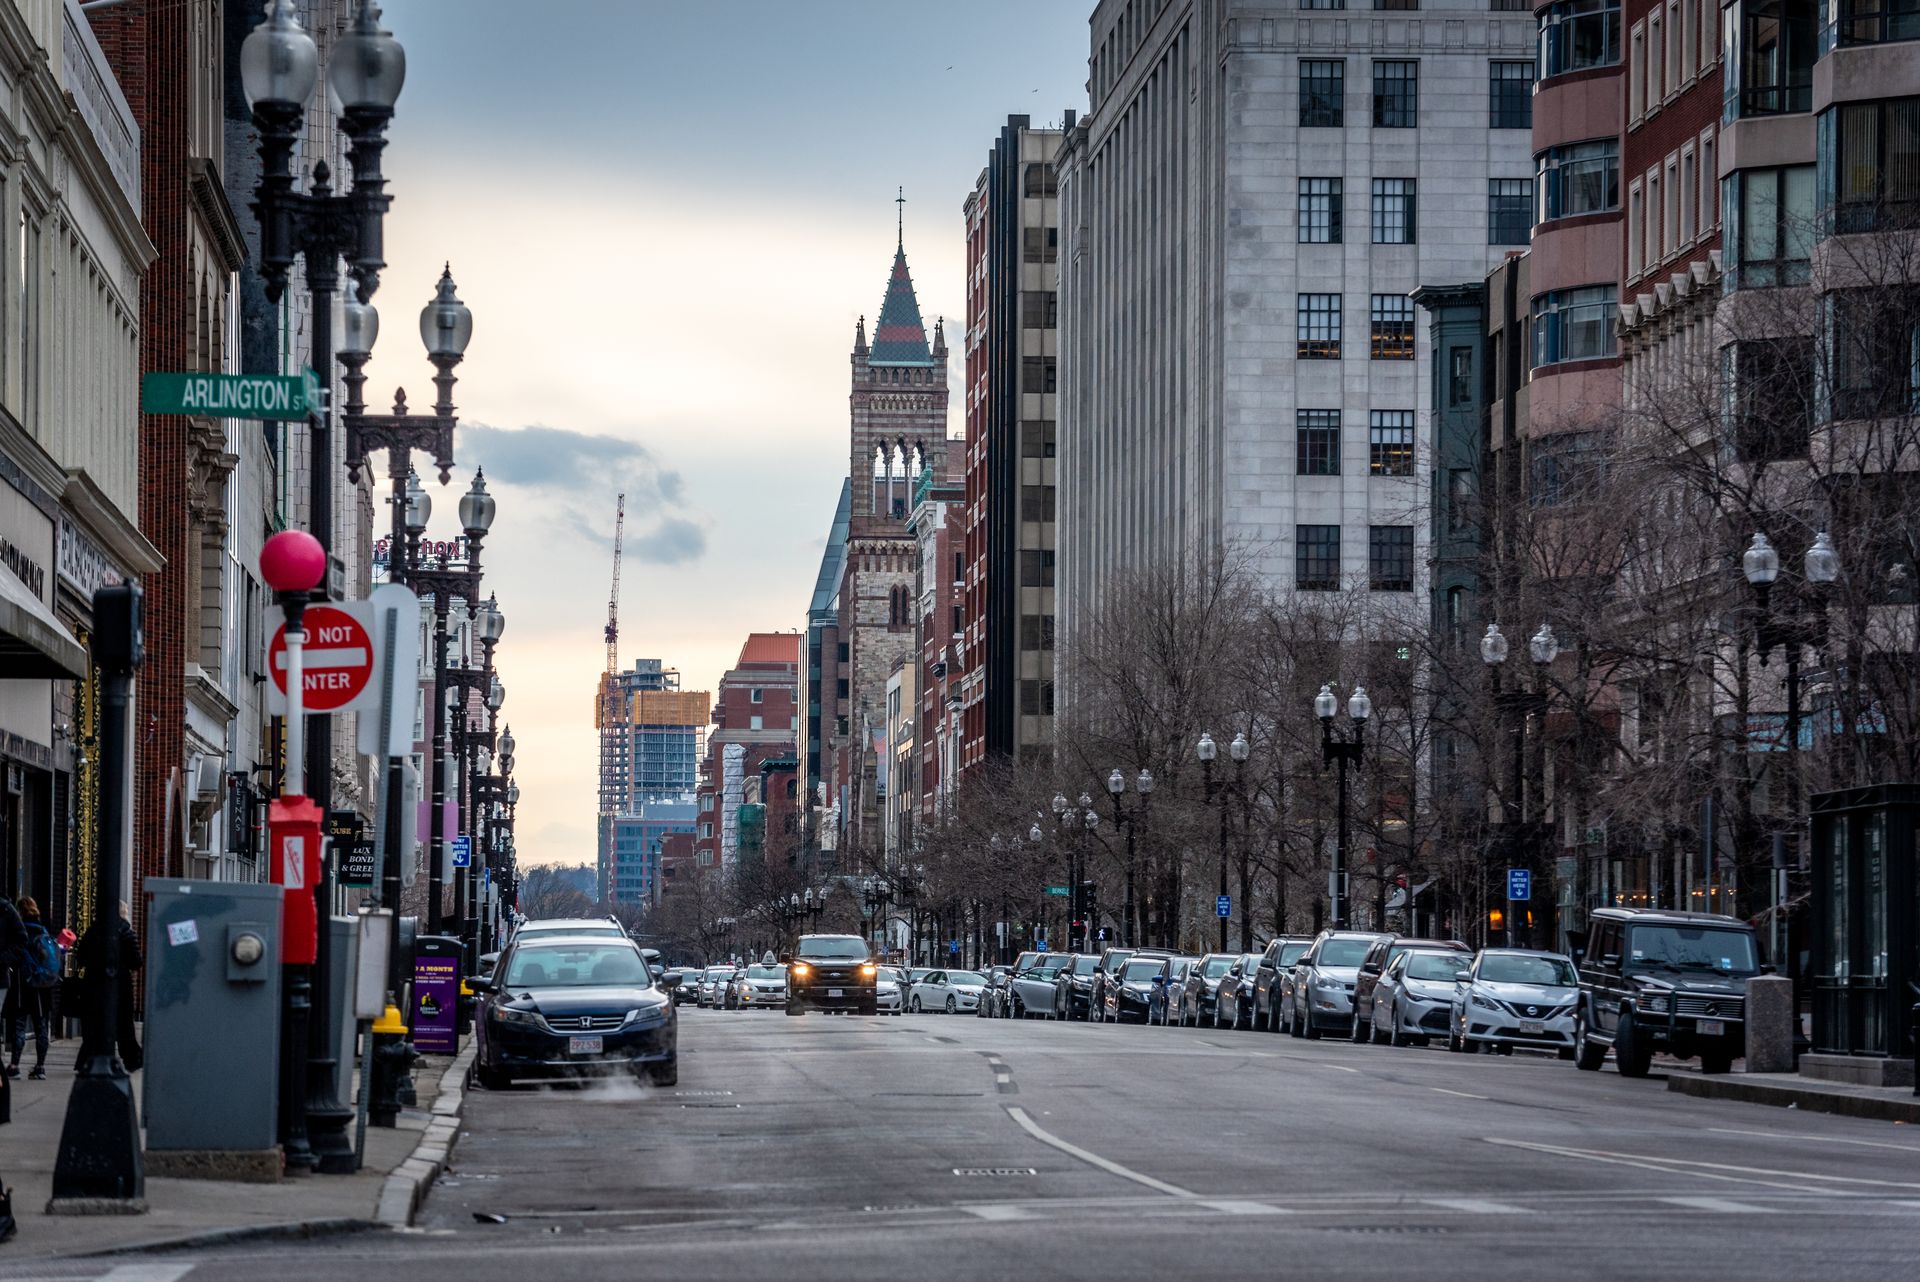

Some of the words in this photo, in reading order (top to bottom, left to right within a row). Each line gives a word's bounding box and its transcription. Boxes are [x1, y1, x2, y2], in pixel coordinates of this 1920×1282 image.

[182, 378, 290, 411] ARLINGTON
[319, 626, 353, 643] NOT
[302, 672, 351, 691] NTER
[341, 864, 349, 872] &
[350, 864, 374, 872] GREE
